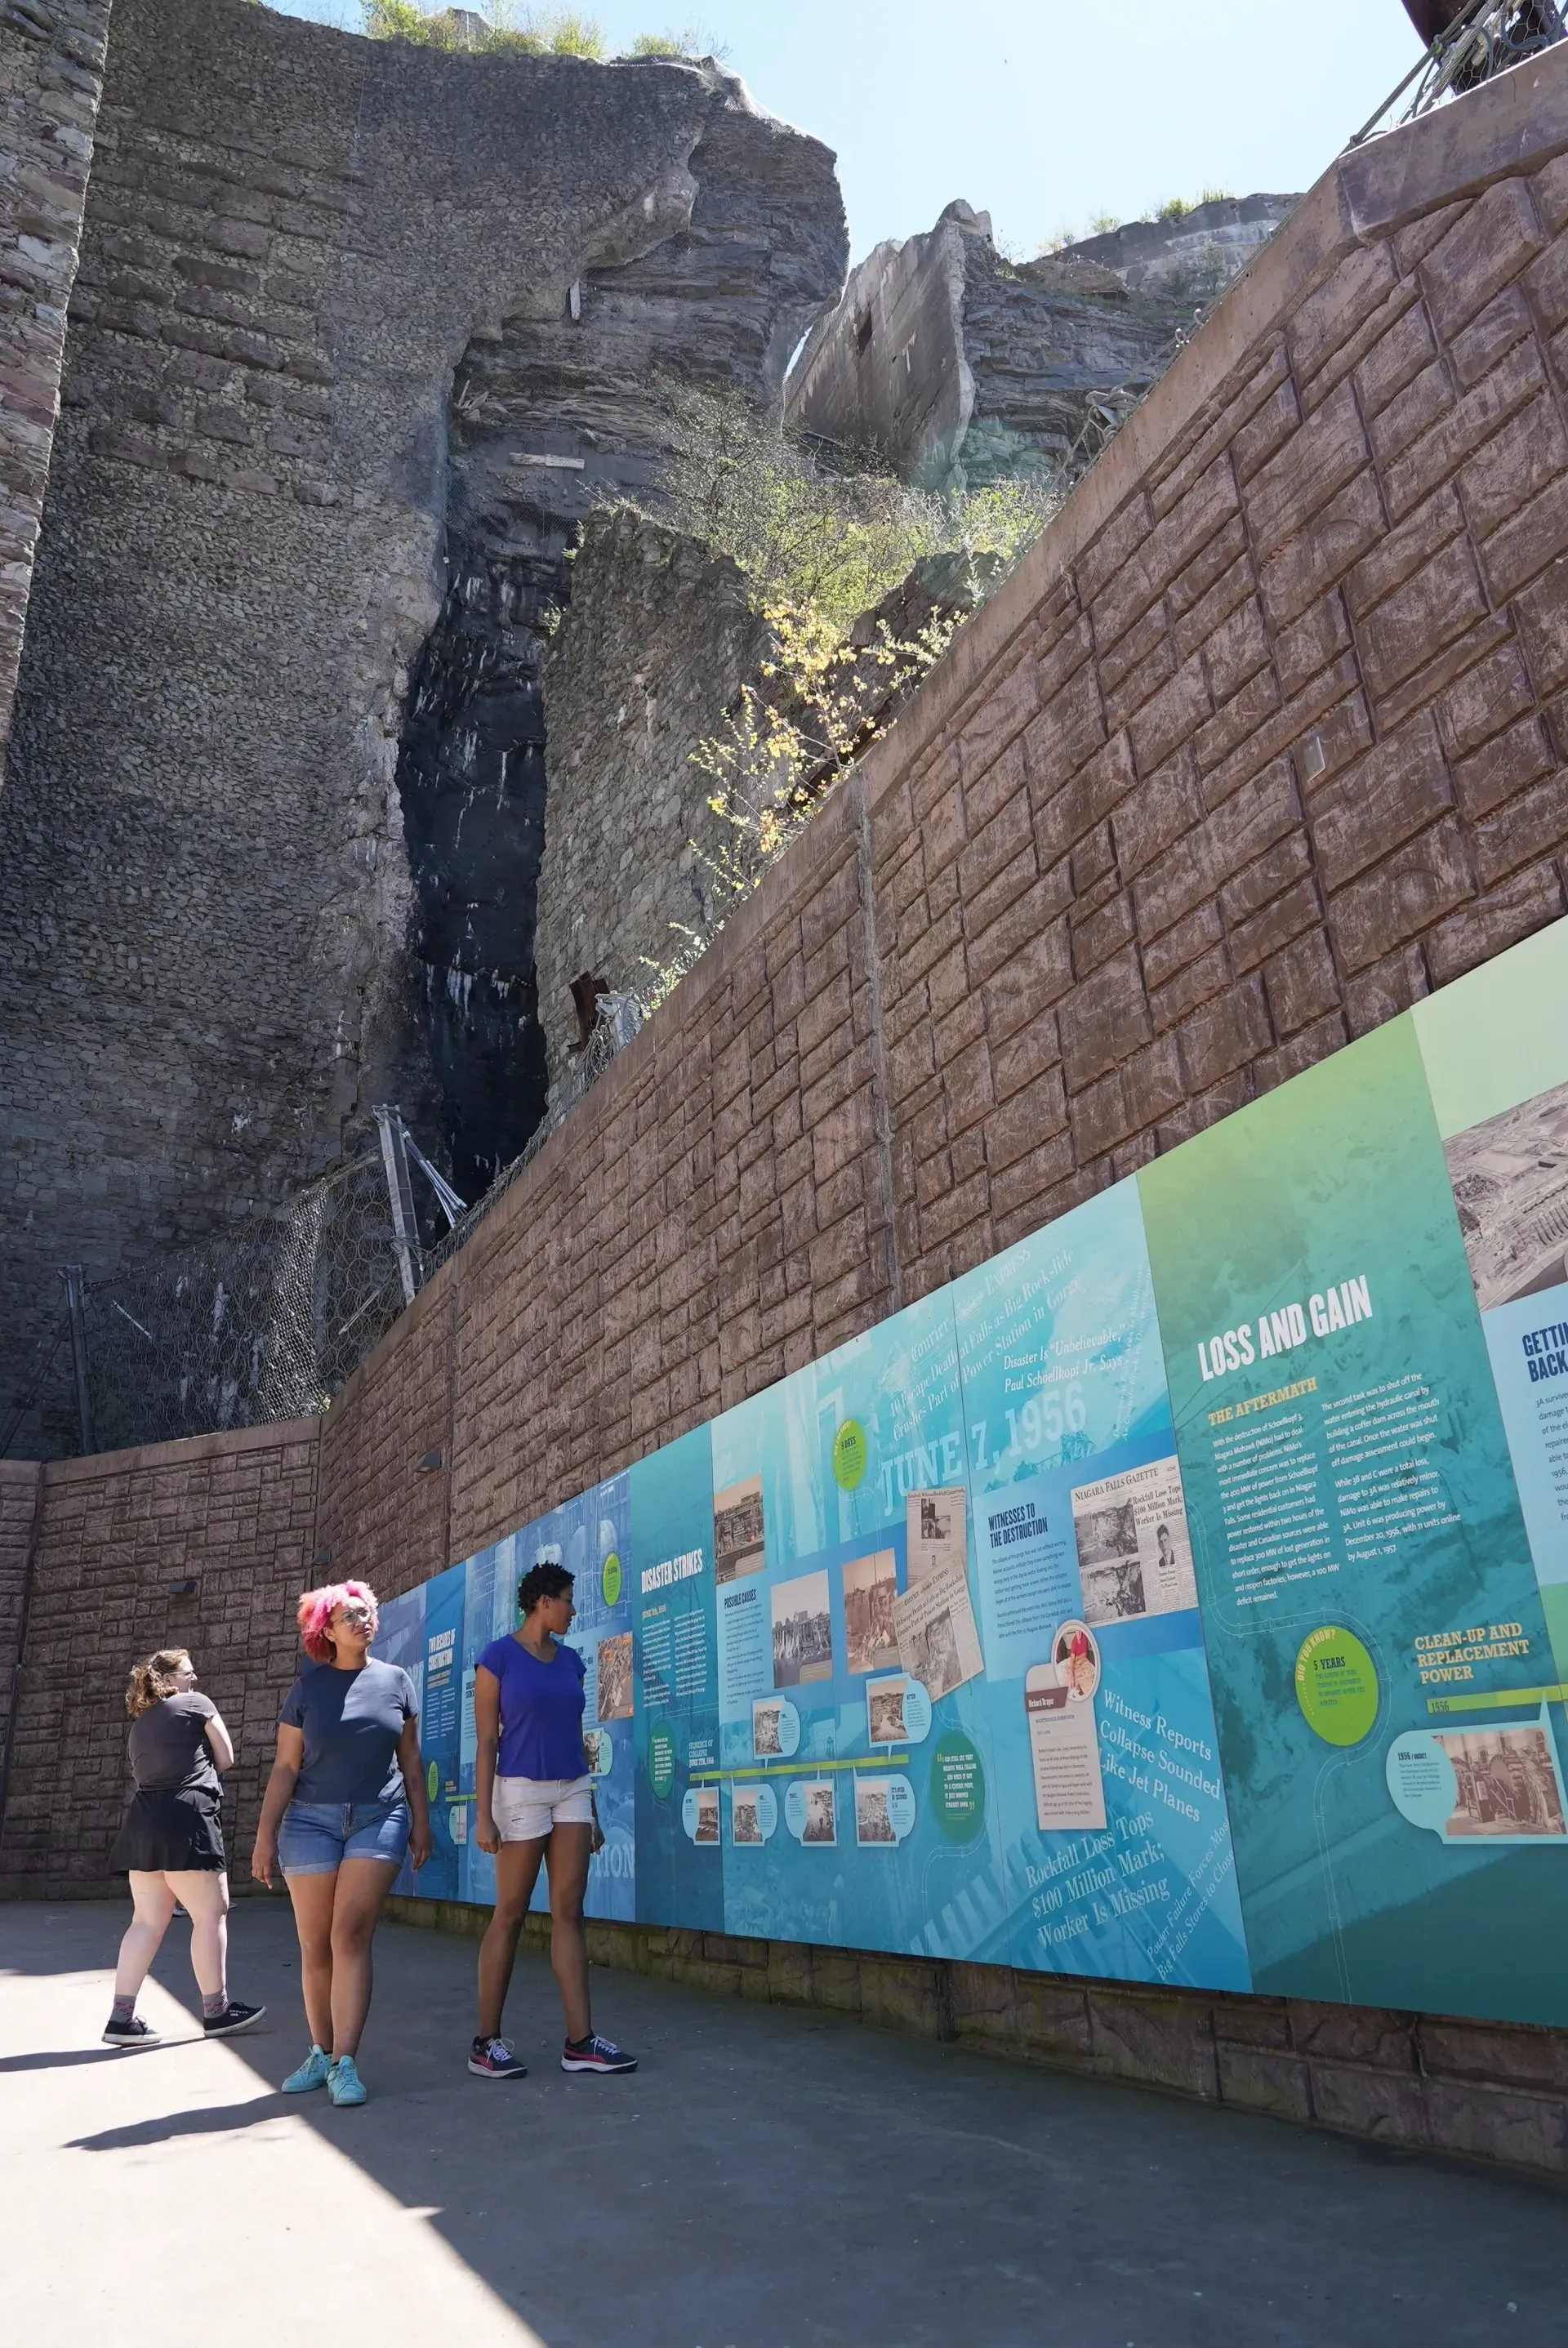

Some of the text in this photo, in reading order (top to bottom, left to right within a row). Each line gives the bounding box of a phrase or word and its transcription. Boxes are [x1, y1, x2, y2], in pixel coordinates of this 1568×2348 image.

[1198, 1274, 1373, 1382] LOSS AND GAIN
[893, 1276, 1080, 1441] Crushes Part of Power Station in Gorge
[902, 1378, 930, 1408] Escape
[931, 1348, 958, 1380] Death
[960, 1339, 969, 1359] at
[970, 1319, 992, 1348] Falls
[994, 1312, 1004, 1328] as
[1004, 1296, 1022, 1318] Big
[1004, 1352, 1037, 1370] Disaster
[1040, 1346, 1048, 1361] Is
[1527, 1350, 1568, 1383] BACK
[1005, 1354, 1122, 1392] Paul Schoellkopf Jr. Says
[1208, 1376, 1318, 1426] THE AFTERMATH
[1321, 1373, 1422, 1411] The second task was to shut off the
[1324, 1386, 1428, 1425] water entering the hydraulic canal by
[1545, 1392, 1568, 1404] survive
[1213, 1438, 1225, 1447] With
[1226, 1435, 1234, 1444] the
[1235, 1427, 1262, 1441] destruction
[1263, 1424, 1267, 1432] of
[1268, 1414, 1298, 1429] Schoellkopf
[1326, 1427, 1349, 1439] building
[1355, 1418, 1372, 1431] coffer
[1373, 1415, 1386, 1425] dam
[1388, 1410, 1405, 1421] across
[1406, 1406, 1417, 1415] the
[1419, 1398, 1439, 1411] mouth
[1539, 1409, 1565, 1420] damage
[1542, 1422, 1561, 1435] of the
[879, 1431, 963, 1516] JUNE
[1005, 1380, 1086, 1457] 1956
[1329, 1415, 1437, 1453] of the canal. Once the water was shut
[1332, 1431, 1437, 1467] off damage assessment could begin.
[1549, 1453, 1561, 1463] able
[1075, 1468, 1158, 1502] NIAGARA FALLS GAZETTE
[1133, 1485, 1180, 1504] Rockfall Loss Tops
[988, 1503, 1036, 1530] WITNESSES TO
[1134, 1496, 1183, 1516] $100 Million Mark;
[1136, 1508, 1183, 1526] Worker Is Missing
[990, 1517, 1048, 1548] THE DESTRUCTION
[641, 1560, 673, 1593] DISASTER
[674, 1548, 703, 1581] STRIKES
[724, 1589, 756, 1609] POSSIBLE CAUSES
[1236, 1591, 1278, 1606] deficit remained.
[1300, 1643, 1312, 1662] YOU
[1310, 1628, 1335, 1646] KNOW?
[1414, 1622, 1522, 1651] CLEAN-UP AND
[1417, 1640, 1530, 1667] REPLACEMENT
[1313, 1656, 1346, 1670] 5 YEARS
[1420, 1666, 1474, 1684] POWER
[1431, 1700, 1449, 1713] 1956
[1104, 1689, 1211, 1761] Witness Reports
[1101, 1720, 1220, 1800] Collapse Sounded
[1397, 1752, 1411, 1761] 1956
[1129, 1767, 1149, 1793] Jet
[1153, 1778, 1200, 1821] Planes
[1025, 1811, 1153, 1889] Rockfall Loss Tops
[1032, 1840, 1165, 1920] $100 Million Mark;
[1037, 1878, 1170, 1949] Worker Is Missing
[1147, 1926, 1169, 1962] Power
[1167, 1887, 1192, 1928] Failure
[1188, 1848, 1214, 1888] Forces
[1157, 1849, 1234, 1980] Big Falls Stores to Close
